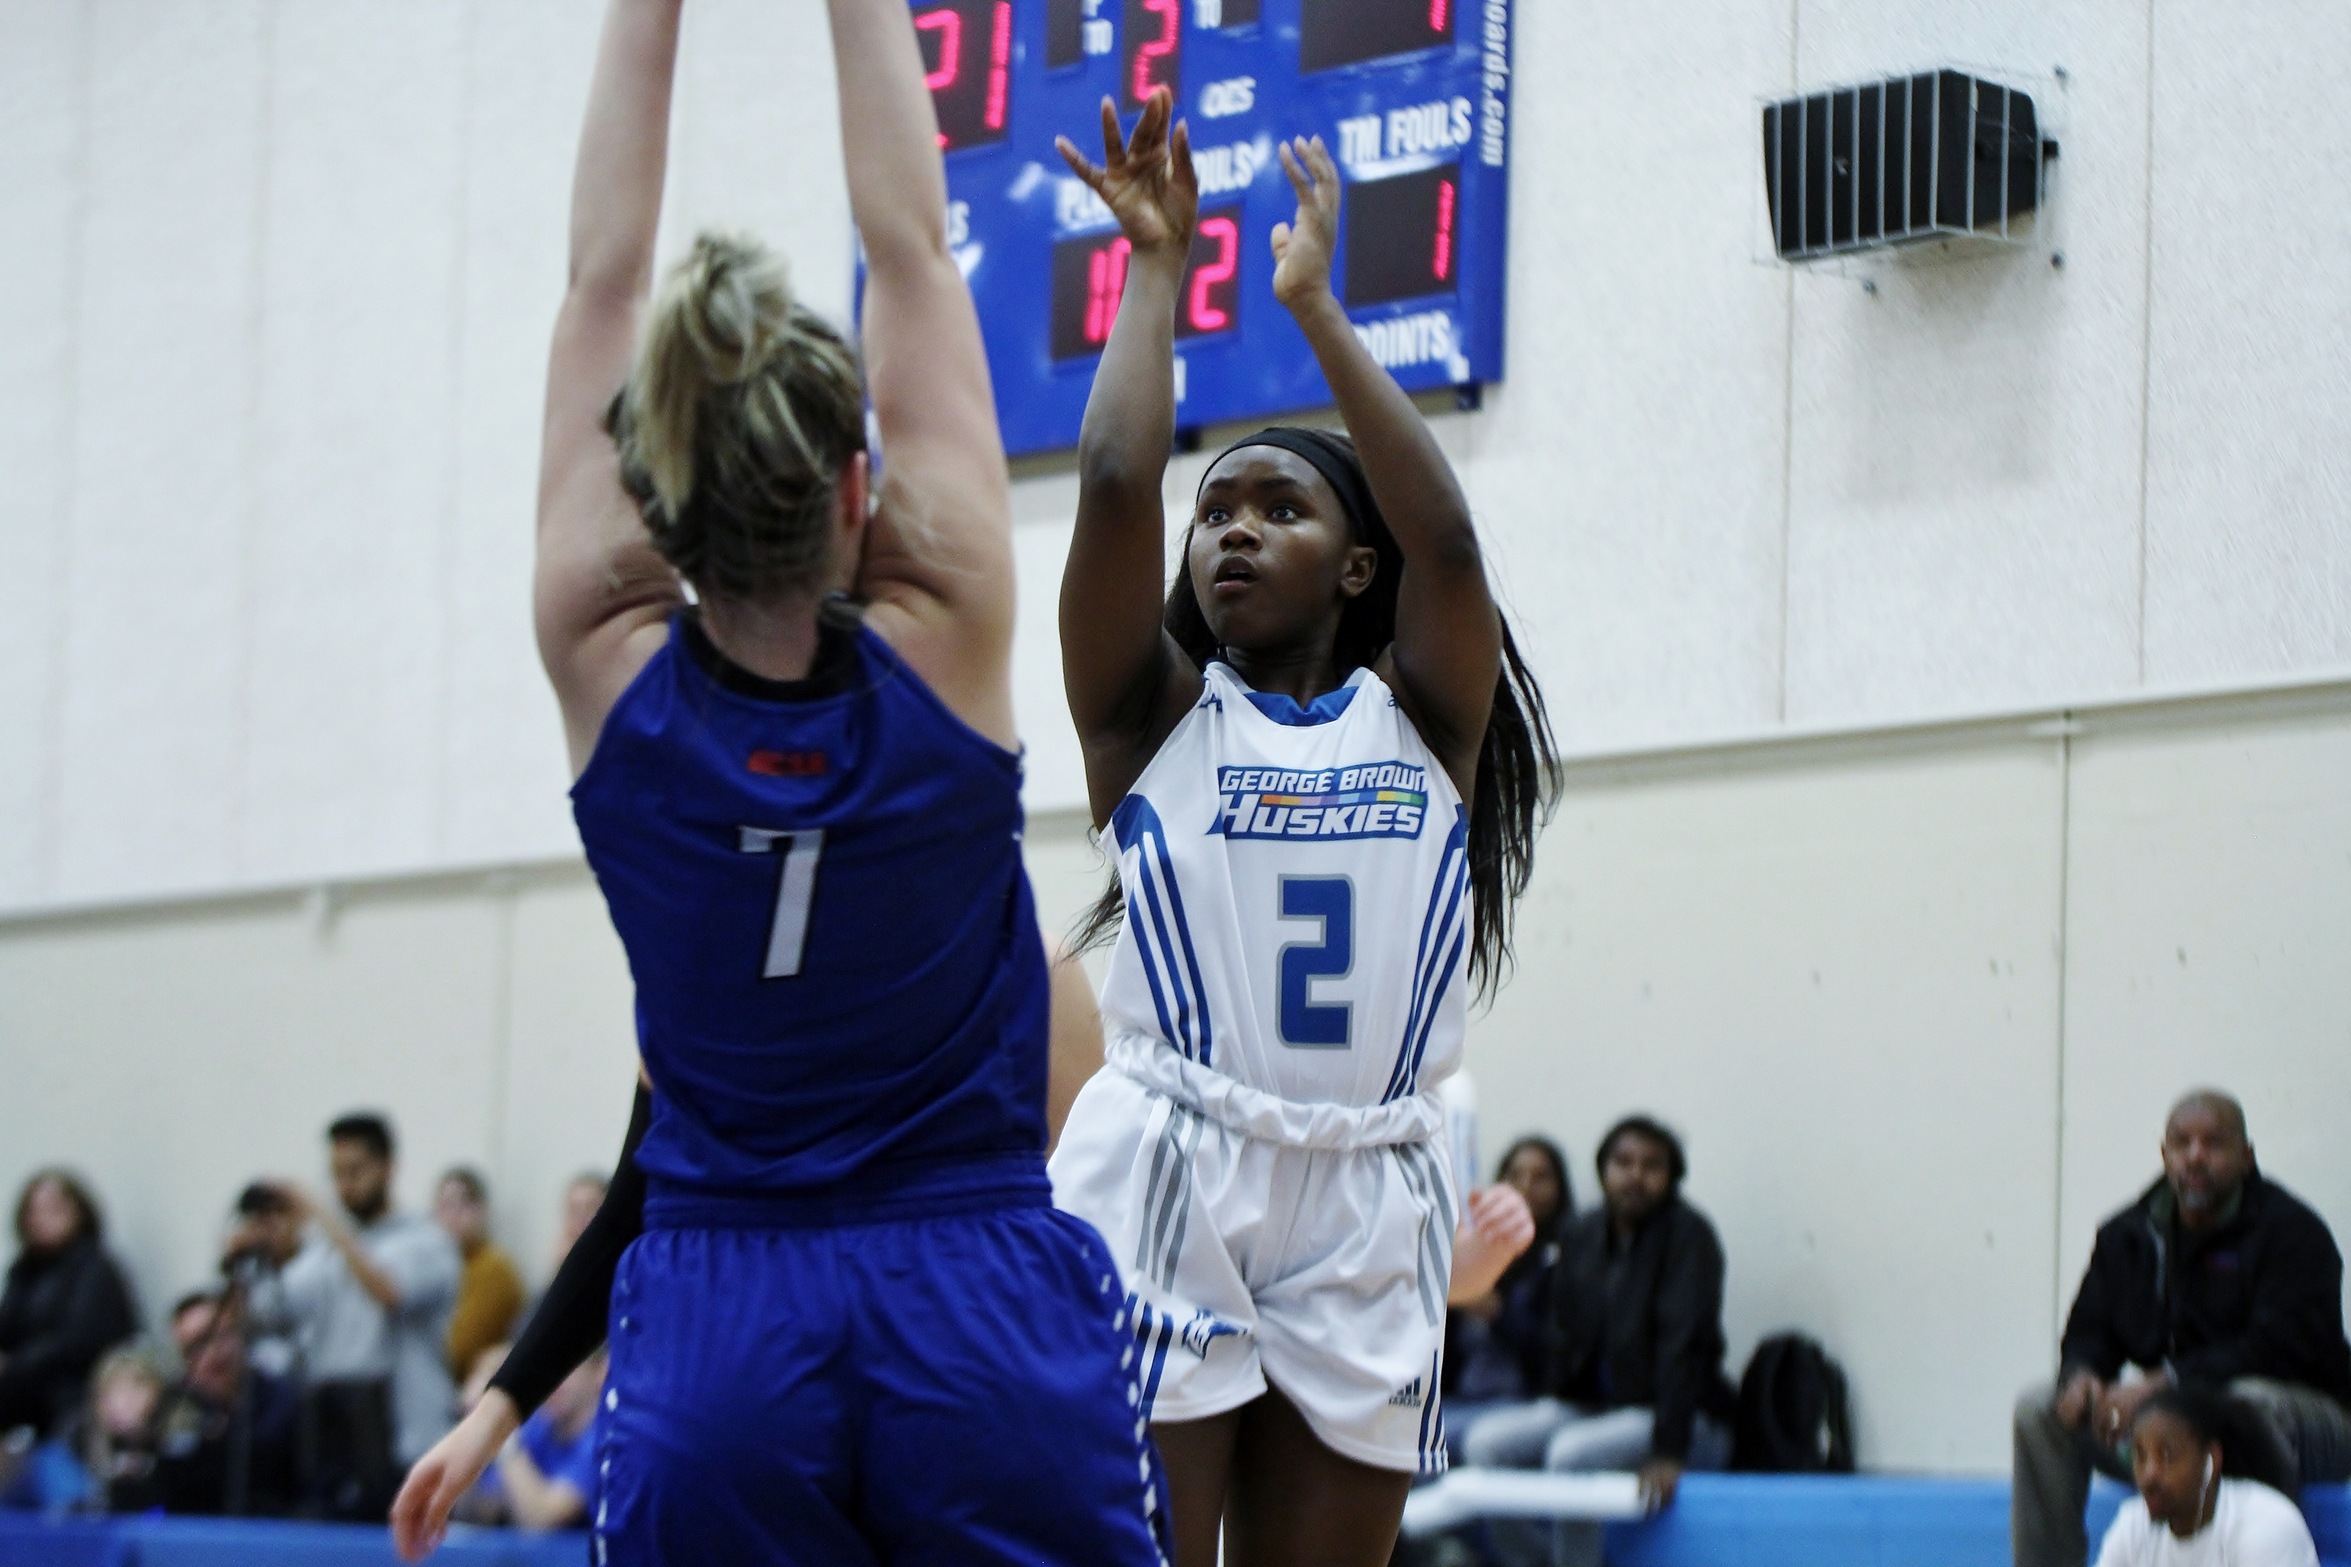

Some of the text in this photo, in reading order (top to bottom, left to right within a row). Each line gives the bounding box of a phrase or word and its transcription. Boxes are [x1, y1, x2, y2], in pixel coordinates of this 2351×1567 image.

[1386, 96, 1473, 157] FOULS
[1189, 216, 1239, 331] 2
[1432, 179, 1455, 280] 1
[1220, 764, 1429, 794] GEORGE BROWN
[1220, 793, 1423, 835] HUSKIES
[738, 825, 827, 980] 7
[1276, 873, 1357, 1051] 2
